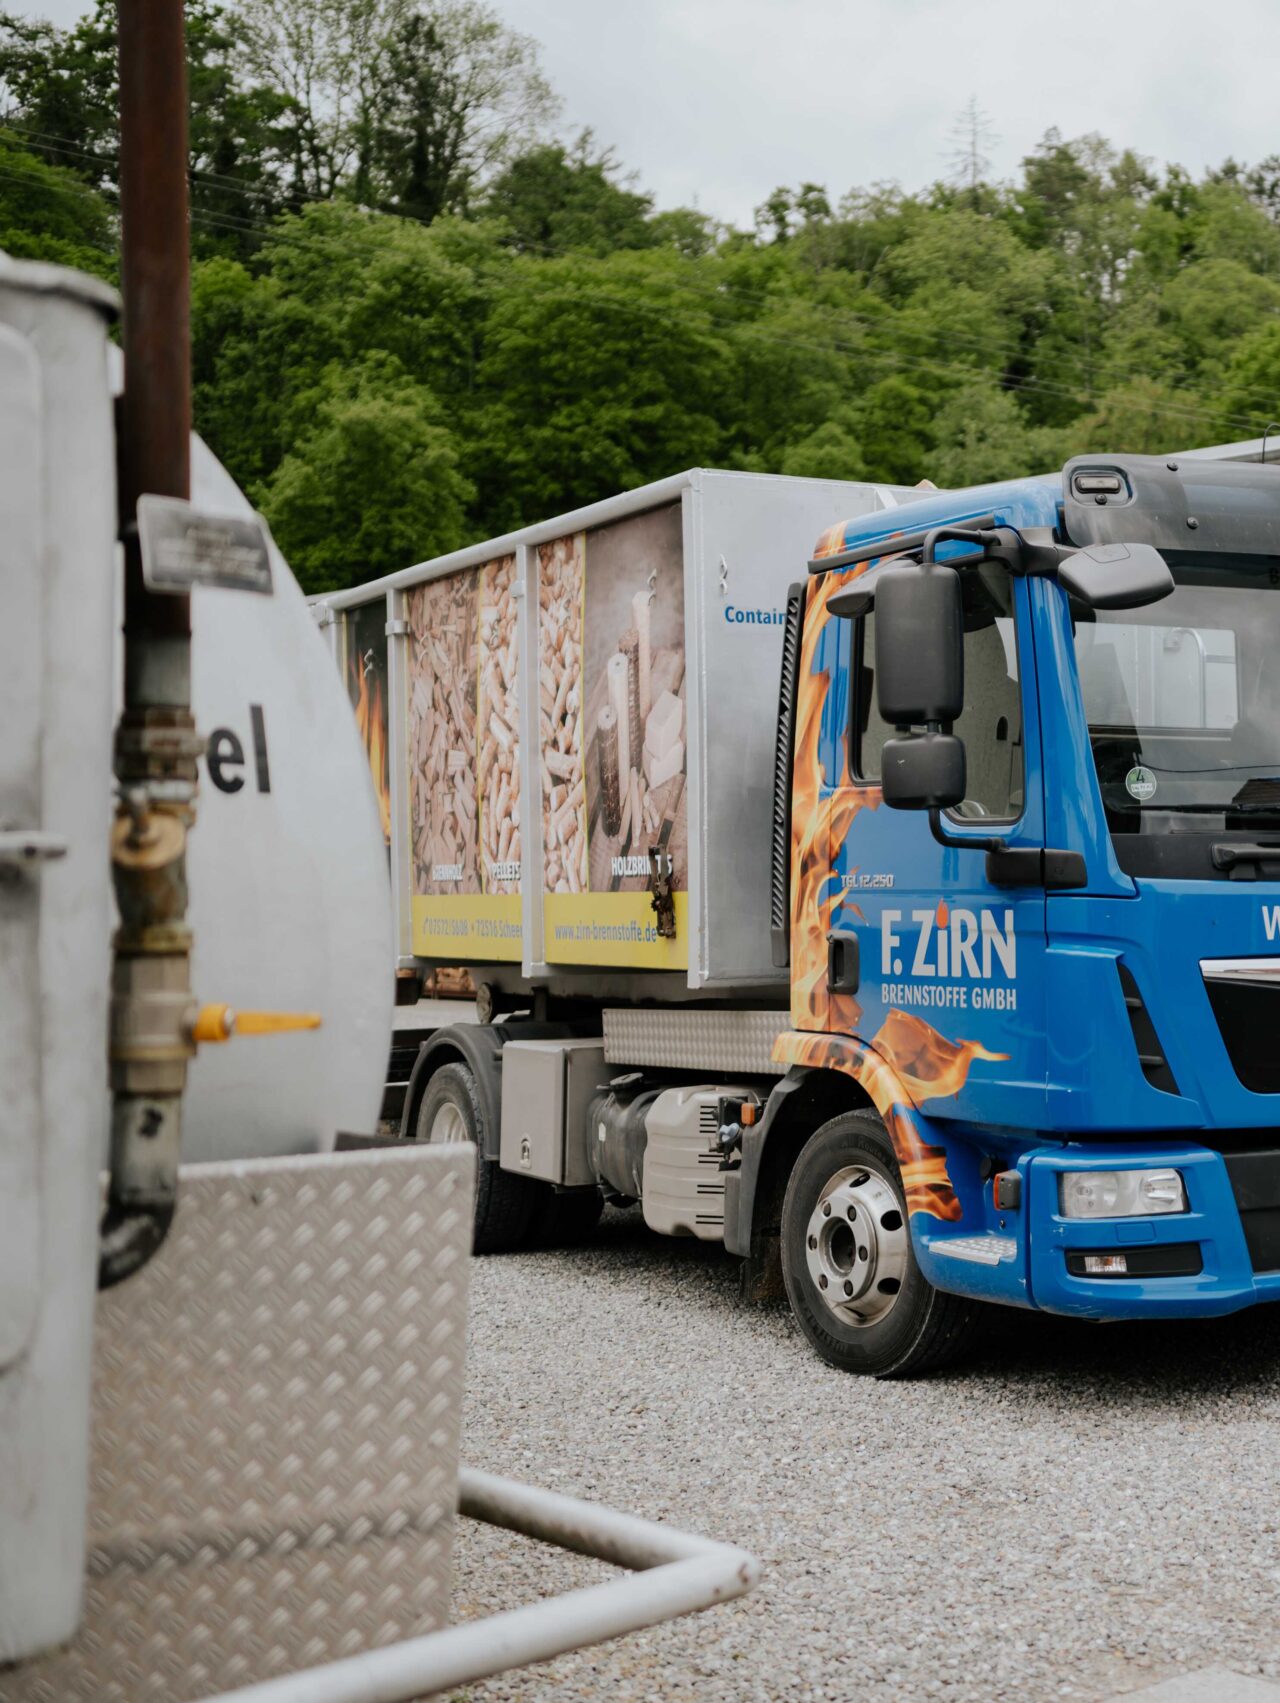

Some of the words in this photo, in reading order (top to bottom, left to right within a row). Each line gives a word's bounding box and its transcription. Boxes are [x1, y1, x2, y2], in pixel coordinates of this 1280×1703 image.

[492, 860, 522, 881] PELLETS
[555, 920, 657, 943] www.zirn-brennstoffe.de
[881, 909, 903, 976] F.
[881, 983, 967, 1008] BRENNSTOFFE
[972, 986, 1017, 1010] GMBH
